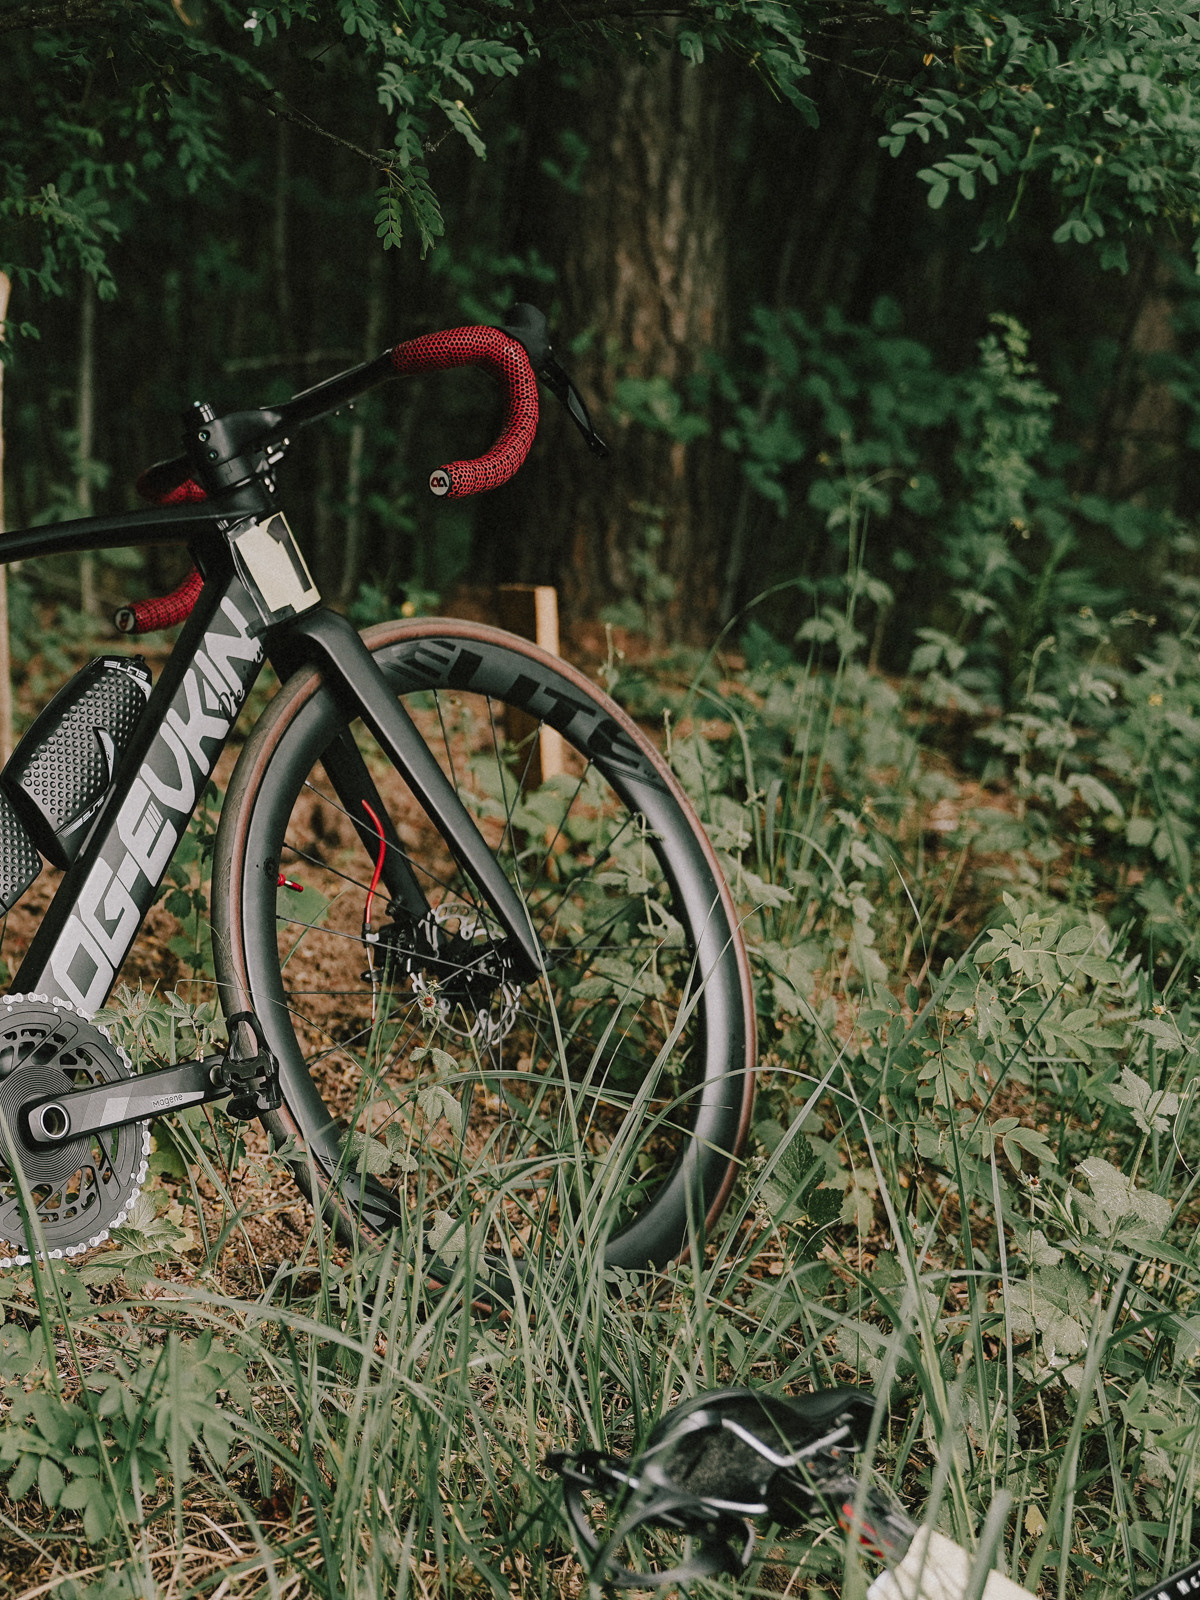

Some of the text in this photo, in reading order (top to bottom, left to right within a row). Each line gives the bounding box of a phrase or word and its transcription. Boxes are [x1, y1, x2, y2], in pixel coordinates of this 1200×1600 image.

[266, 514, 313, 593] 1
[103, 660, 148, 681] ELITE
[152, 1094, 184, 1107] Magene
